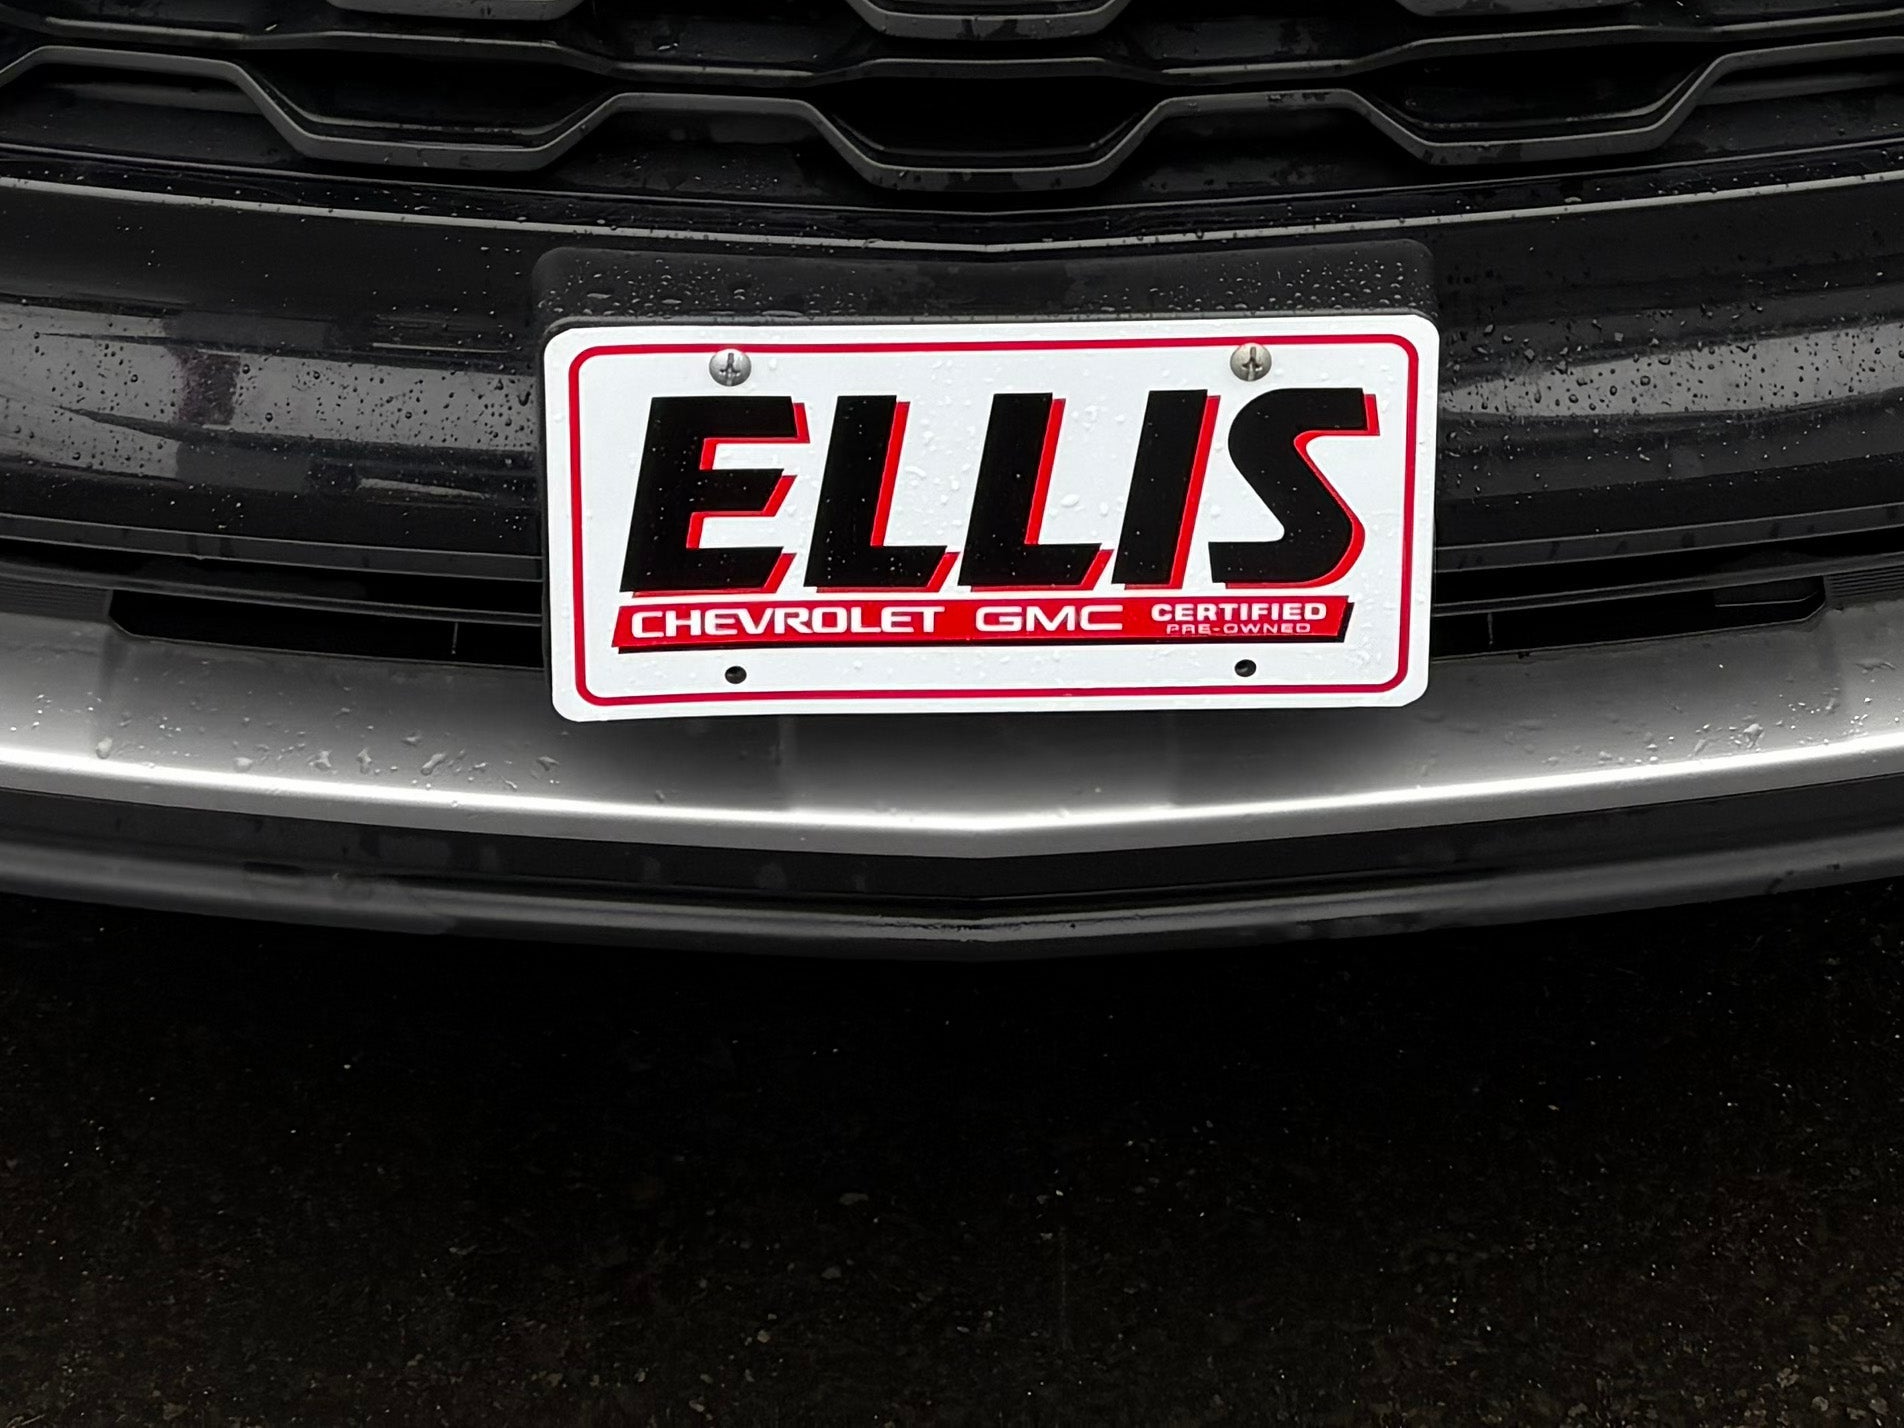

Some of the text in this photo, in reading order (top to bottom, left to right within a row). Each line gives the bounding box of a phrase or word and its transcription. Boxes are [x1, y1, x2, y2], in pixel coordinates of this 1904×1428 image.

[619, 387, 1381, 597] ELLIS
[631, 601, 1328, 639] CHEVROLET GMC CERTIFIED
[1165, 622, 1311, 636] PRE-OWNED
